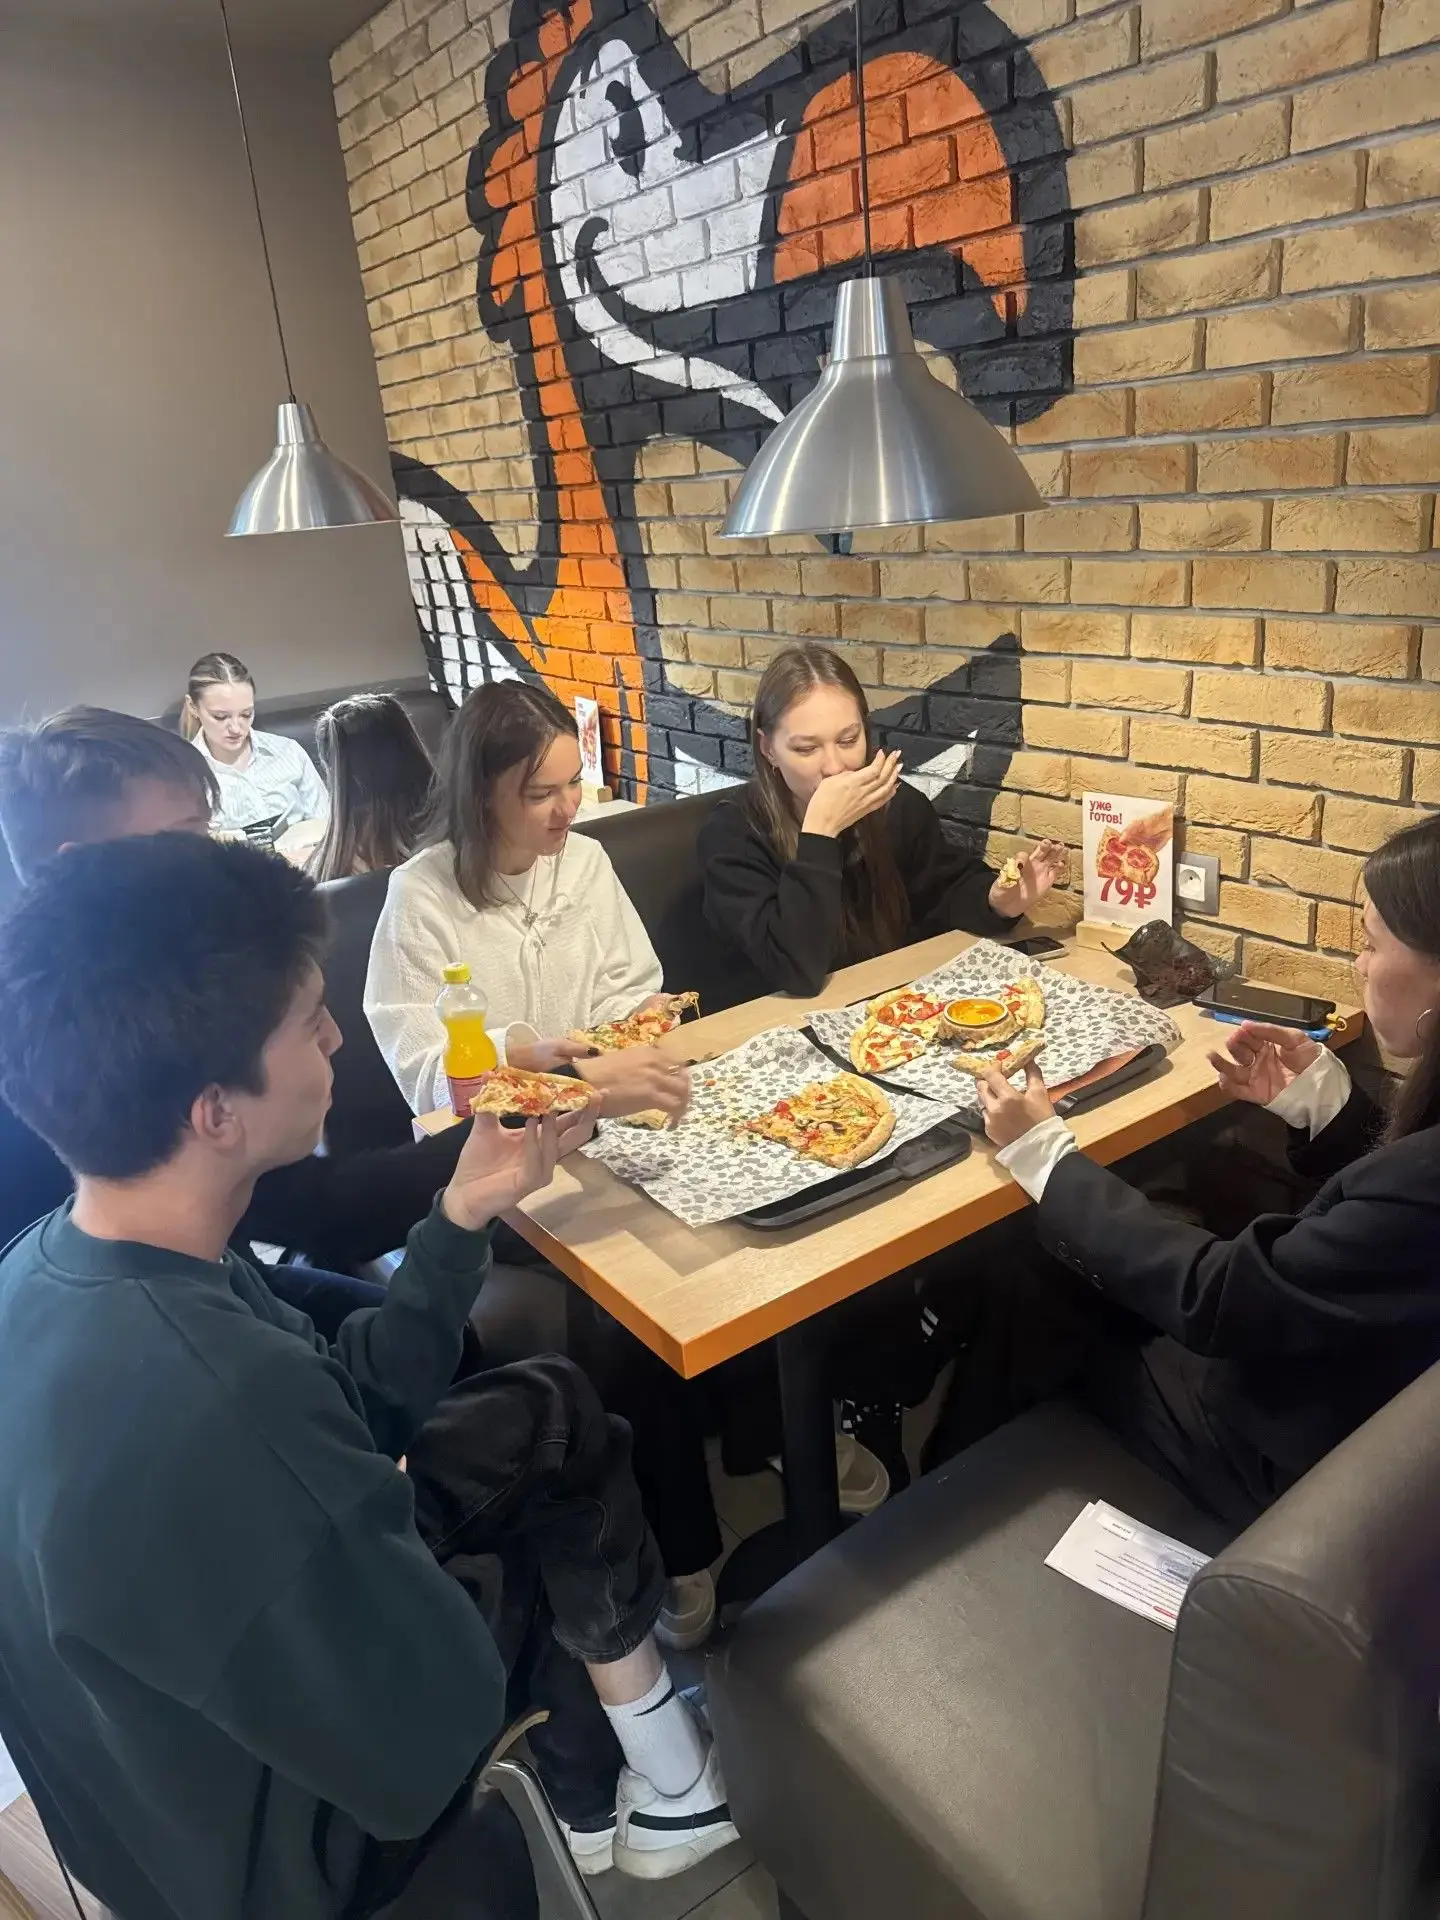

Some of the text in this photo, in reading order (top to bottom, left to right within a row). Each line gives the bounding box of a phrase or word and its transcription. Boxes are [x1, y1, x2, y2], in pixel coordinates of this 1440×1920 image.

[1089, 800, 1112, 812] уже
[1089, 811, 1123, 825] готов!
[1098, 876, 1157, 909] 79₽
